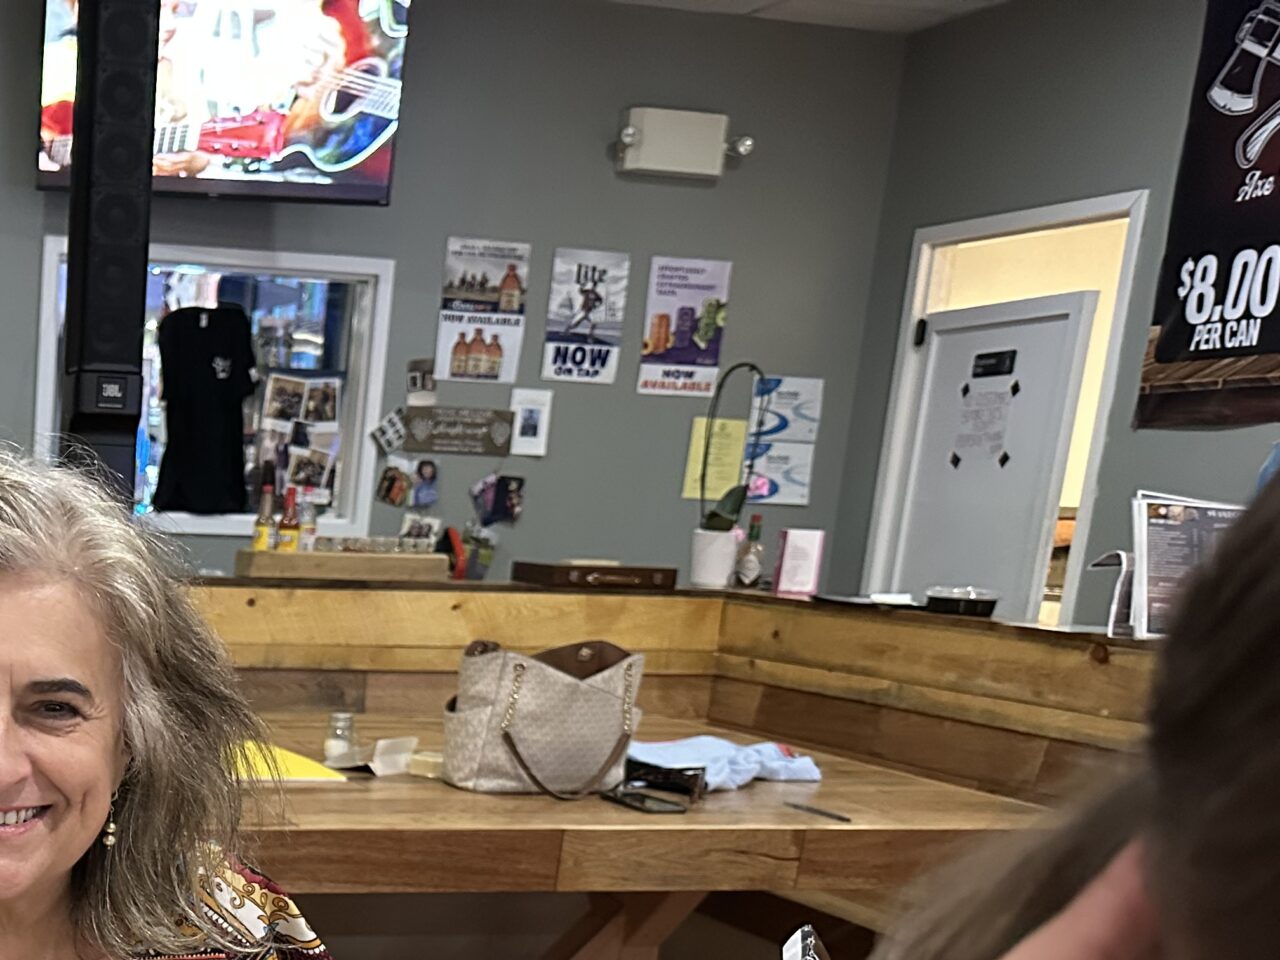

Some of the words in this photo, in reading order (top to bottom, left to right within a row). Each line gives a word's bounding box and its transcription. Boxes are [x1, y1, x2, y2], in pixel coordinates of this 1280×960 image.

[1235, 170, 1275, 202] Axe
[575, 263, 608, 285] lite
[1177, 244, 1280, 325] $8.00
[1189, 323, 1223, 351] PER
[1224, 318, 1261, 348] CAN
[552, 345, 610, 368] NOW
[554, 367, 573, 377] ON
[577, 367, 600, 378] TAP
[662, 369, 696, 379] NOW
[639, 378, 713, 393] AVAILABLE
